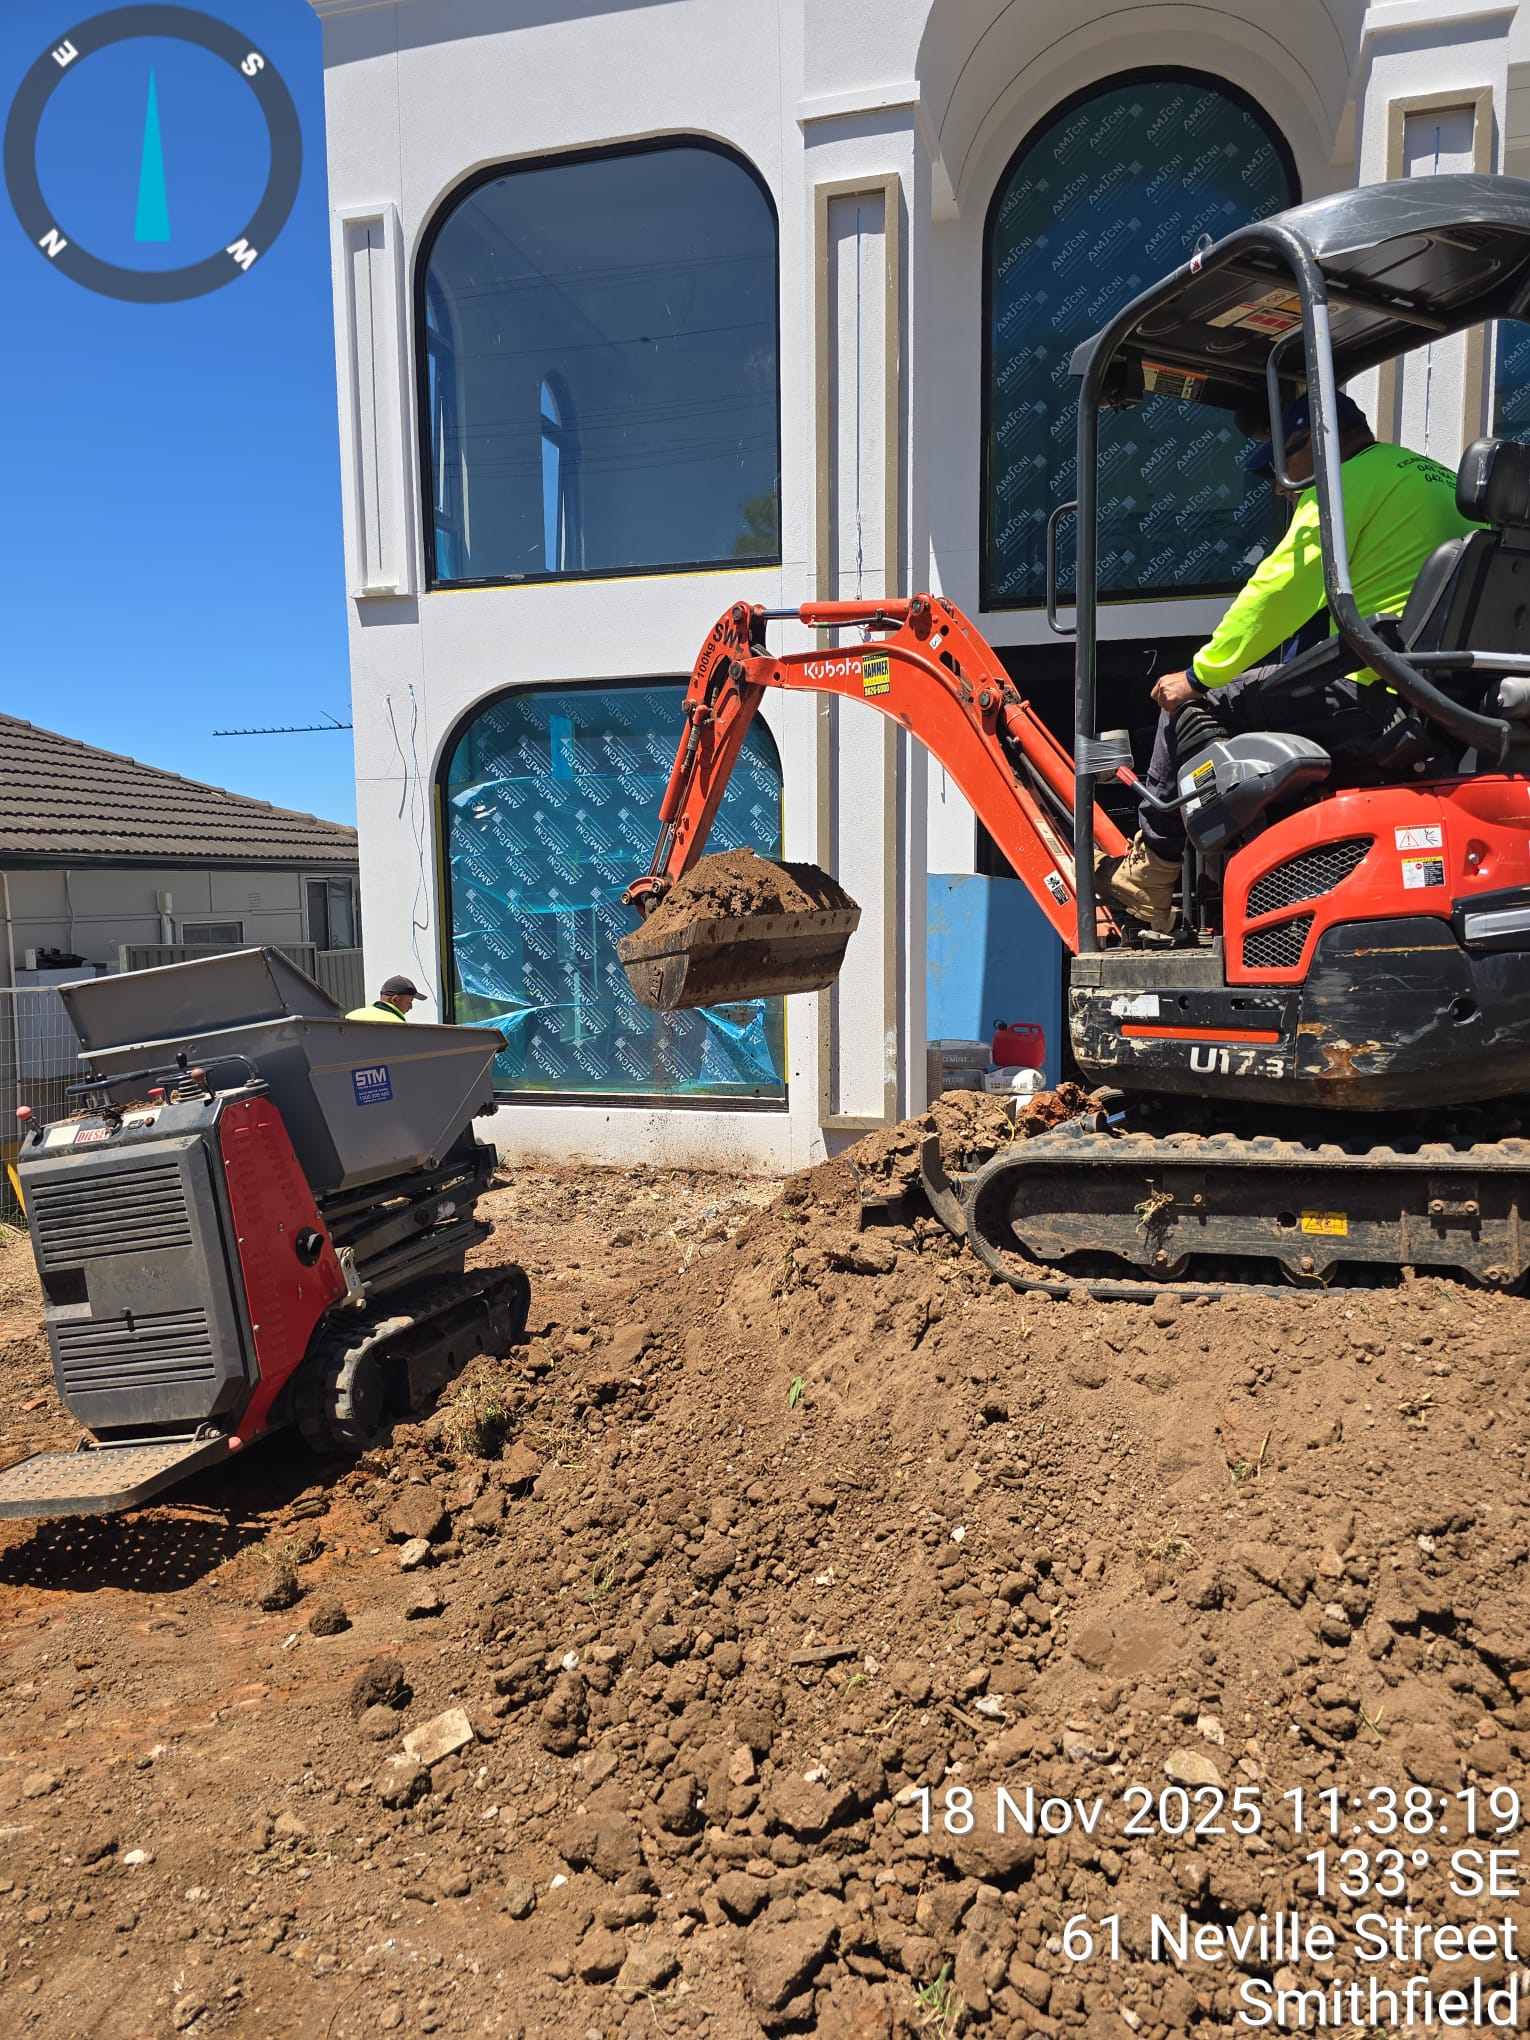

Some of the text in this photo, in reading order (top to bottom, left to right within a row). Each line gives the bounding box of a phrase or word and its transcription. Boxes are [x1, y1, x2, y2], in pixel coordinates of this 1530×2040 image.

[713, 619, 744, 653] SWL
[697, 642, 716, 679] 100kg
[803, 657, 862, 680] Kubota
[863, 660, 889, 679] HAMMER
[356, 1068, 386, 1086] STM
